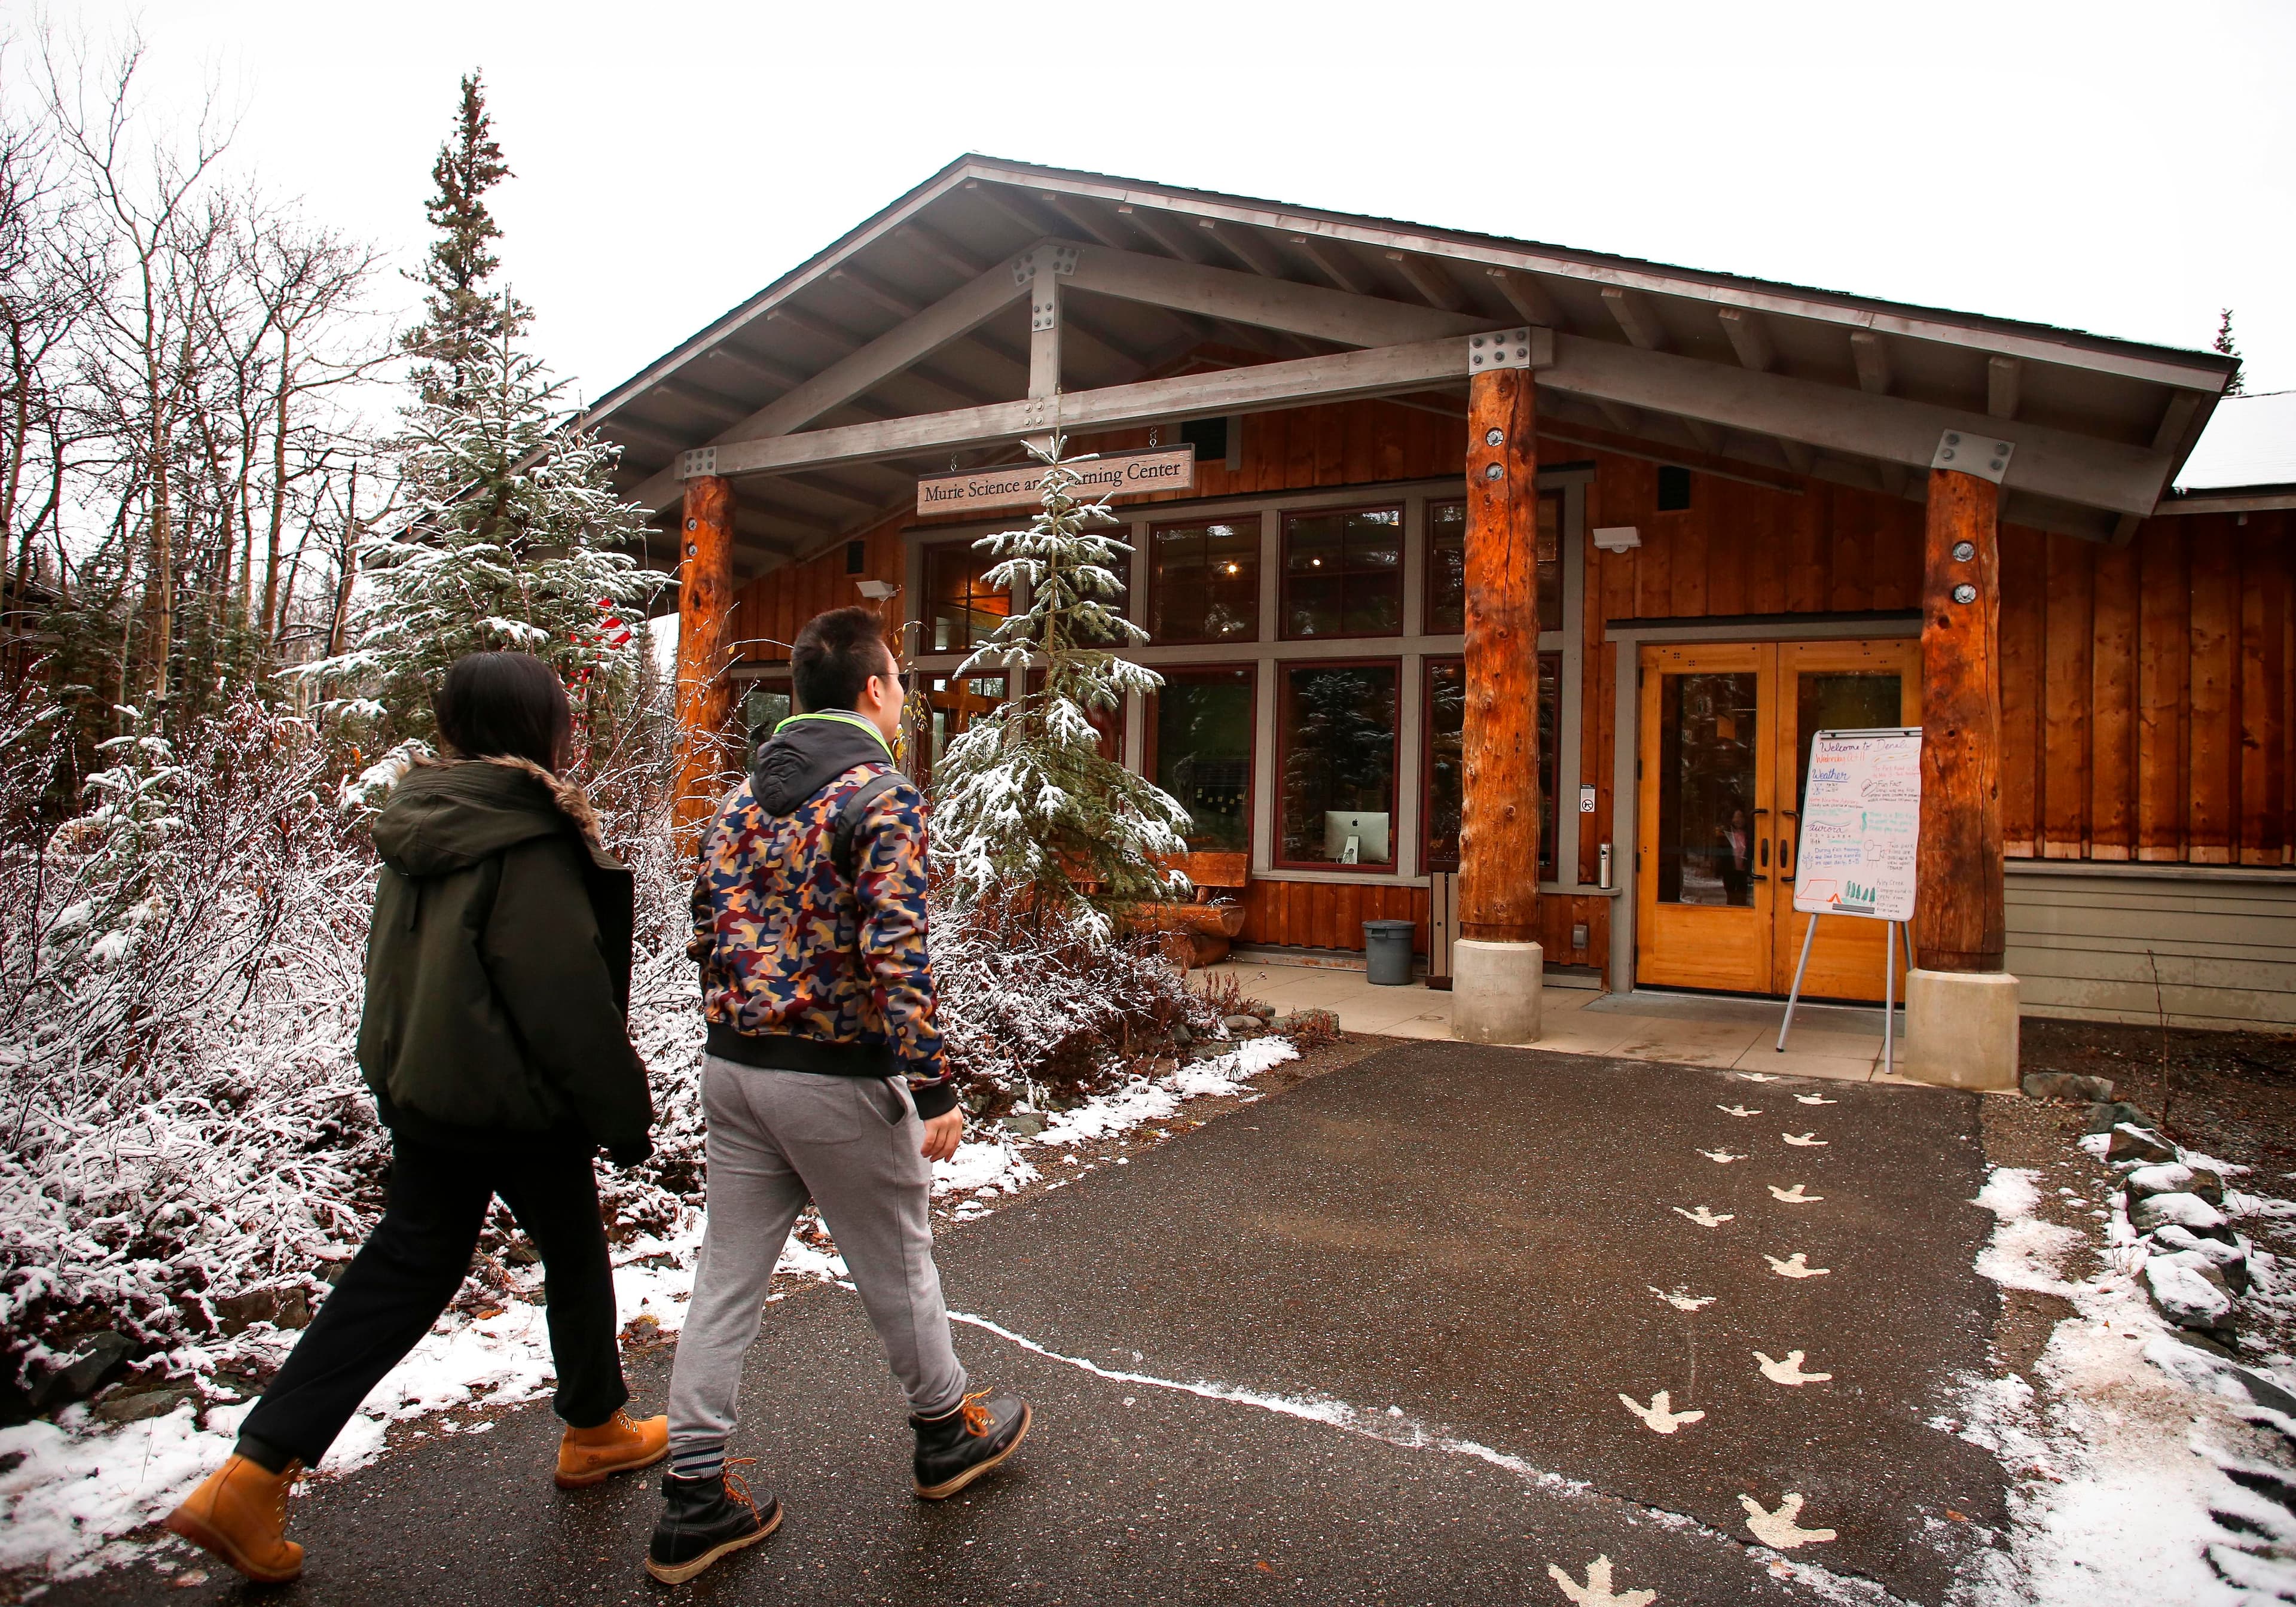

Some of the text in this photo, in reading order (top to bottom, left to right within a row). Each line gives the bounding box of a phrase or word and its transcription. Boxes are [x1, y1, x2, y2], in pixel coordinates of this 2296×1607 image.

[924, 484, 964, 502] Murie
[968, 480, 1020, 498] Science
[1054, 467, 1123, 487] earning
[1127, 463, 1181, 479] Center
[1819, 742, 1860, 752] Welcome
[1863, 741, 1872, 751] to
[1812, 768, 1851, 780] Weather
[1809, 825, 1847, 834] aurora
